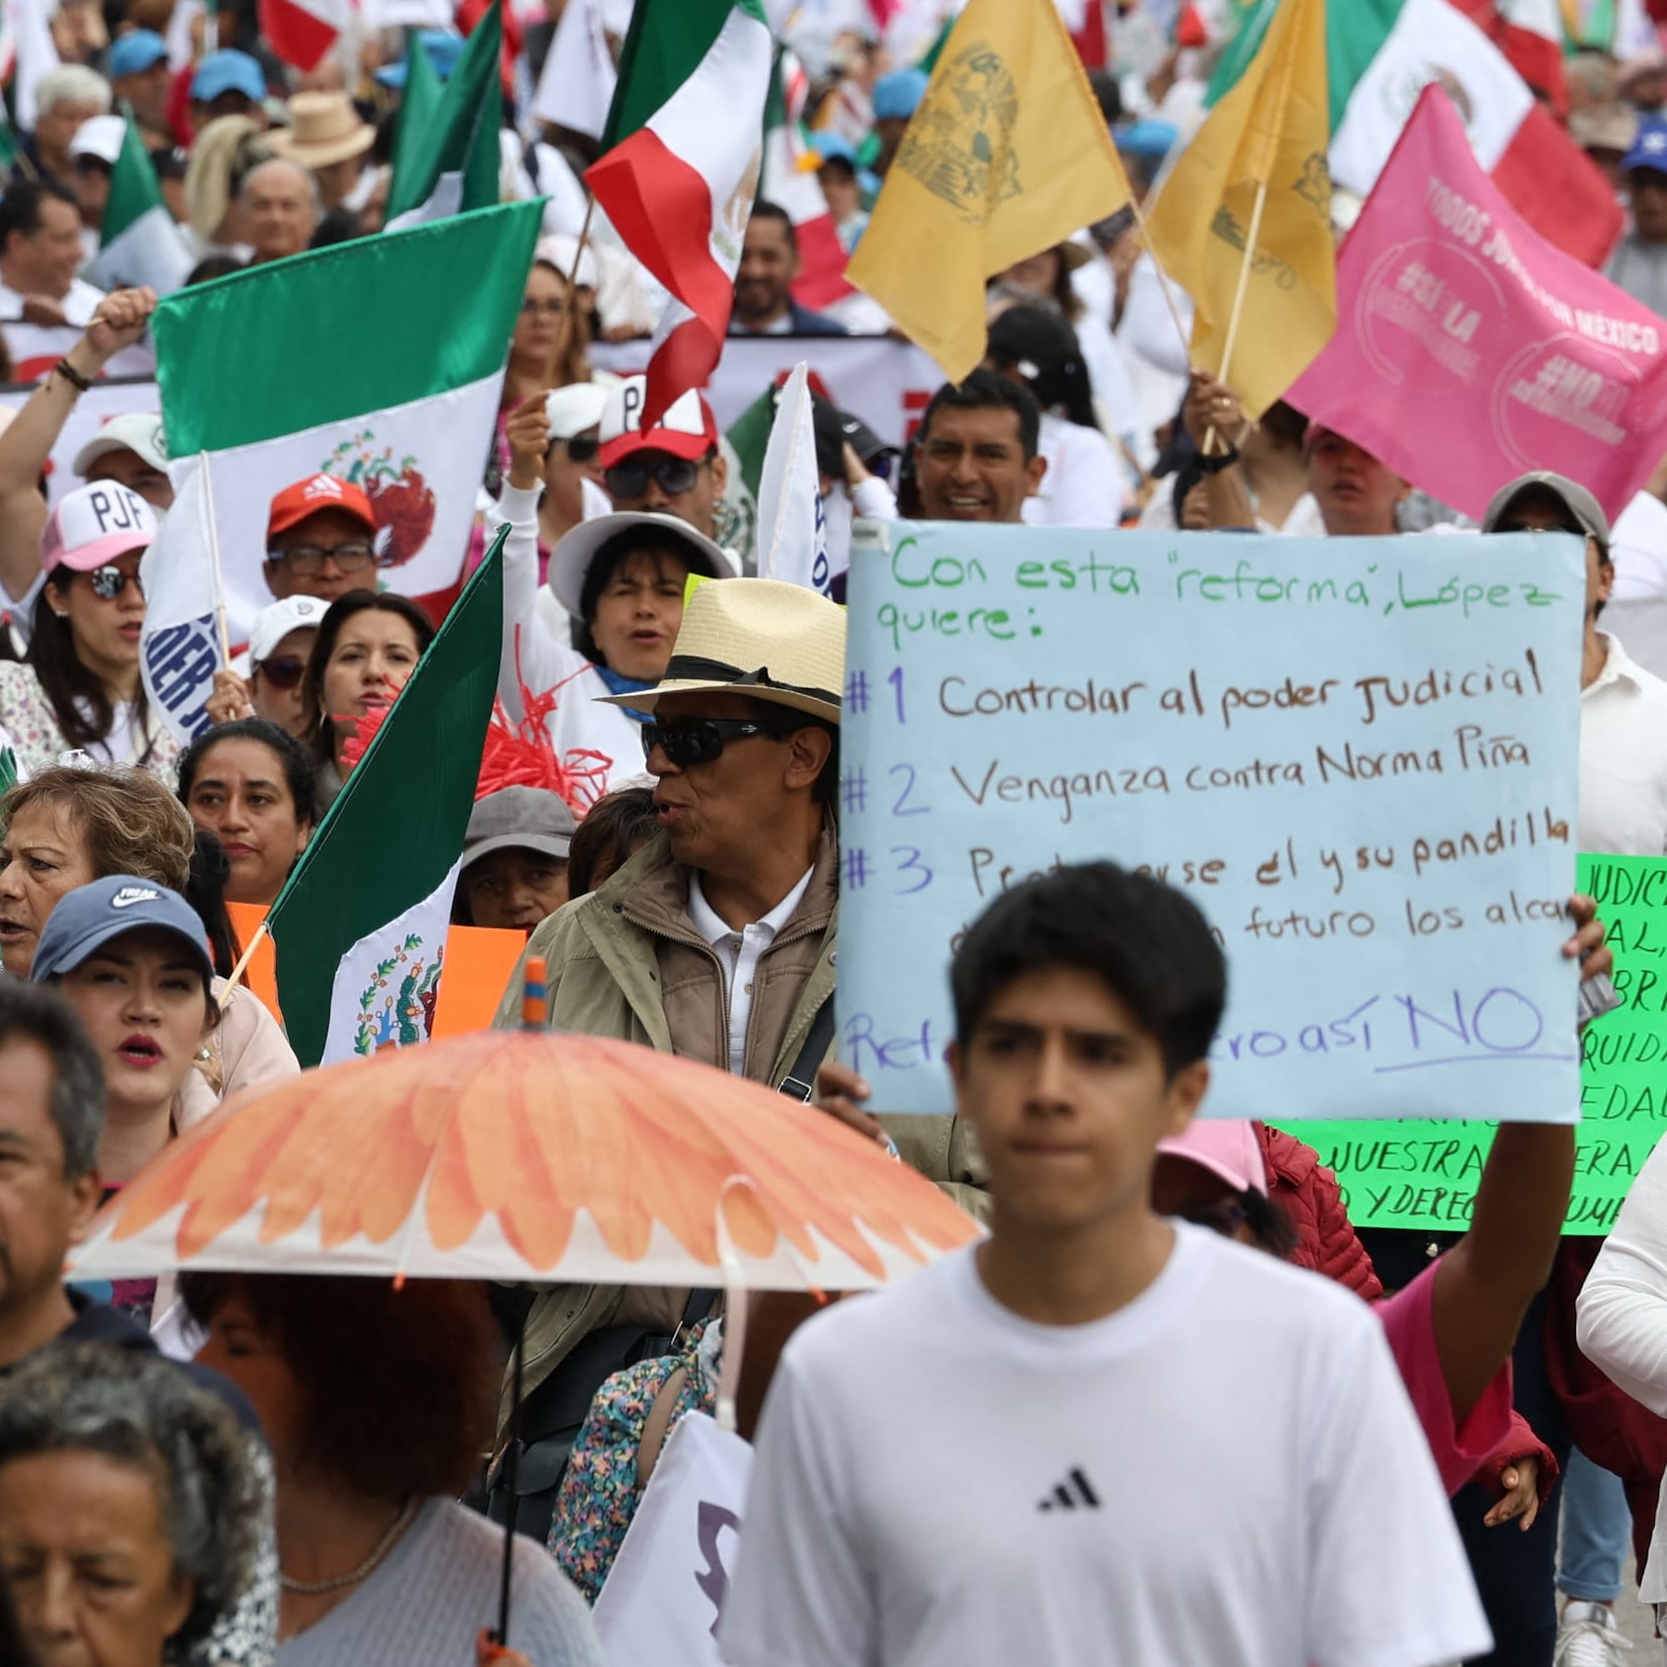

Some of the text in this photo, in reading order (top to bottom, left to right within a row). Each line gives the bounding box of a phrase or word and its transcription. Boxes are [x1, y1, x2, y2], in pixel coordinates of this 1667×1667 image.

[1574, 309, 1660, 356] MÉXICO
[89, 489, 143, 533] PJF
[891, 536, 987, 588] Con
[1016, 550, 1140, 596] esta
[877, 603, 1043, 653] quiere:
[939, 668, 1146, 716] Controlar
[1160, 668, 1204, 717] al
[1221, 678, 1341, 730] poder
[950, 759, 1170, 824] Venganza
[1185, 759, 1305, 790] contra
[1317, 741, 1444, 784] Norma
[1320, 848, 1344, 894] y
[1356, 846, 1395, 870] su
[1587, 864, 1667, 908] JUDIC
[1245, 907, 1375, 939] futuro
[1406, 899, 1464, 936] los
[1394, 986, 1543, 1054] NO
[1328, 1140, 1484, 1180] NUESTRA
